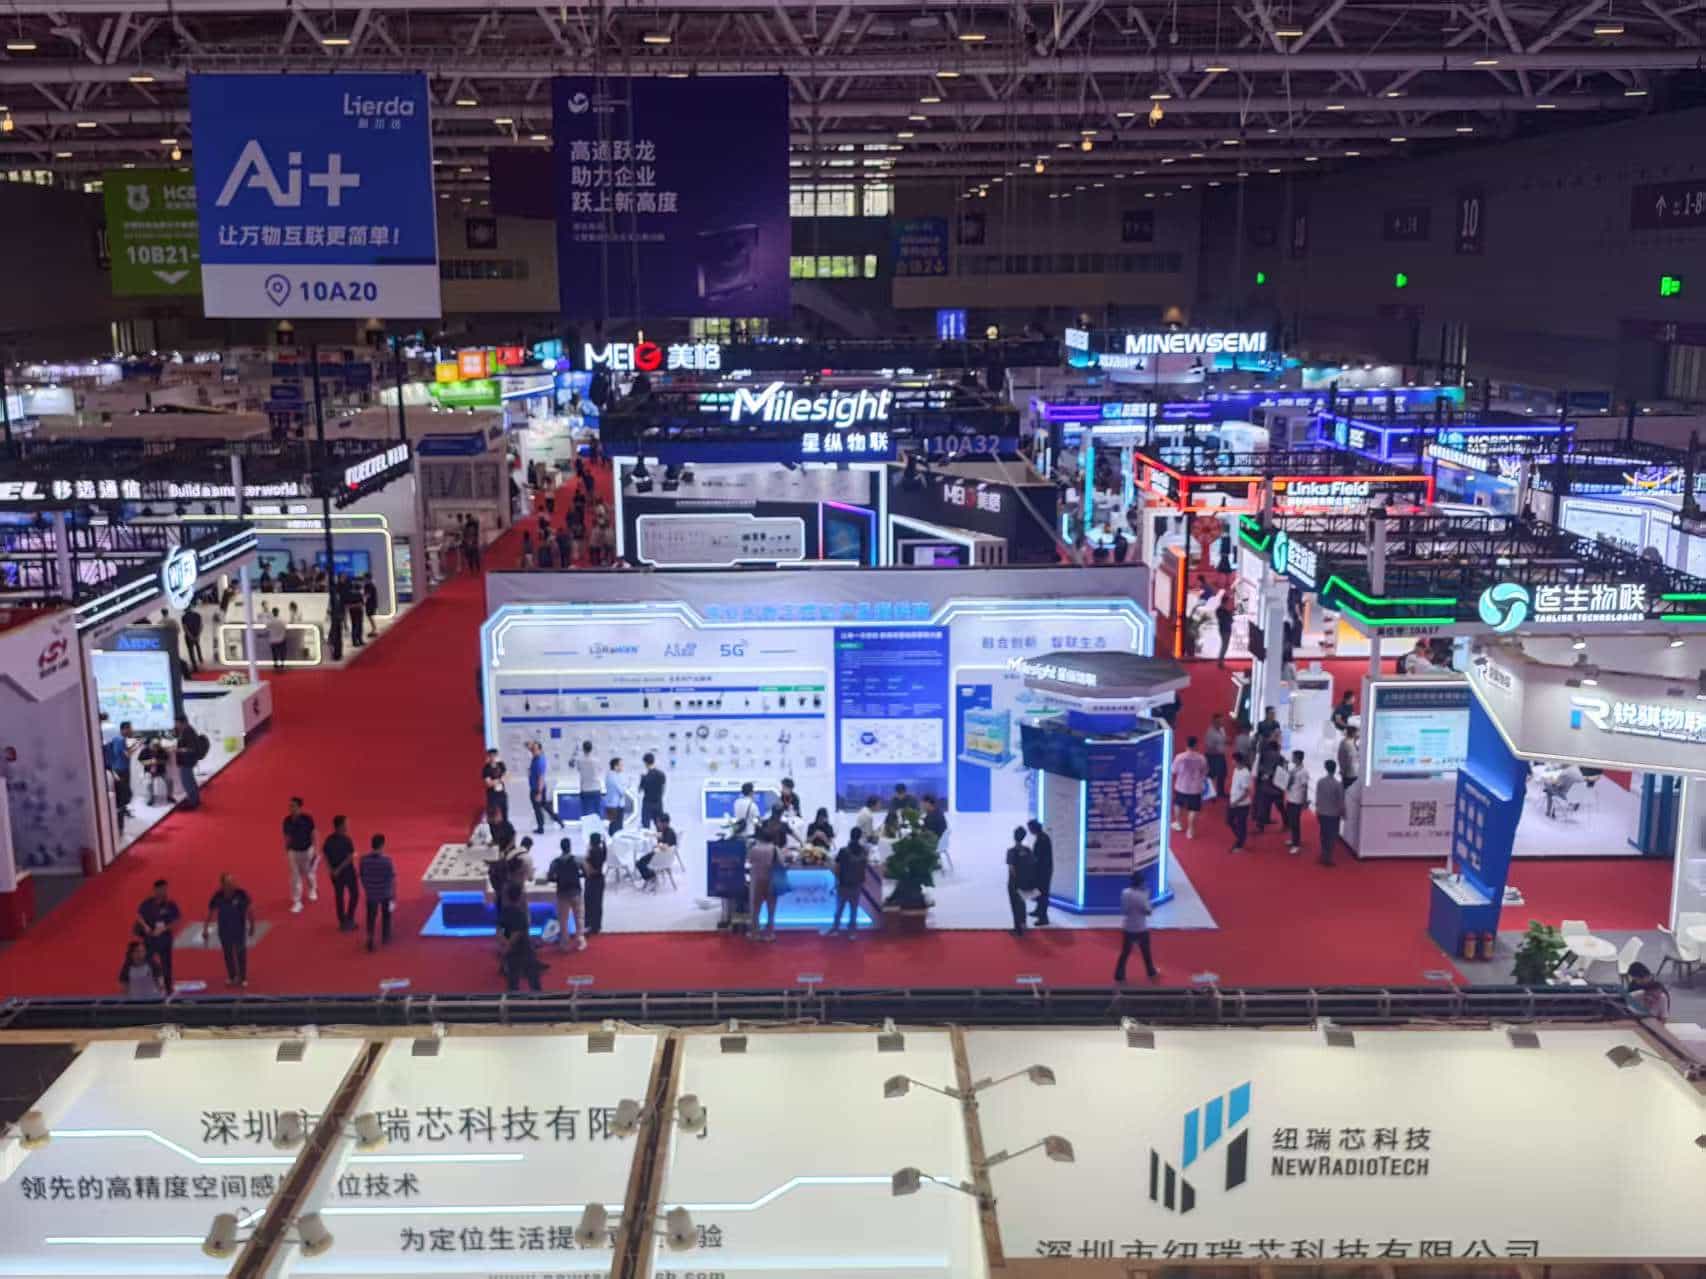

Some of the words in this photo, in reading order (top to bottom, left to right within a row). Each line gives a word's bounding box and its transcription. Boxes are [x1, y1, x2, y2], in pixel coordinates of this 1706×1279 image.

[343, 92, 415, 116] Lierda
[569, 139, 656, 162] 高通跃龙
[571, 165, 657, 187] 助力企业
[571, 190, 679, 214] 跃上新高度
[299, 281, 378, 301] 10A20
[1125, 332, 1267, 354] MINEWSEMI
[667, 343, 721, 370] 美格
[729, 381, 894, 428] Milesight
[801, 433, 889, 452] 星纵物联
[933, 434, 1000, 454] 10A32
[1286, 481, 1329, 496] Links
[1331, 481, 1369, 496] Field
[719, 643, 744, 656] 5G
[1271, 1127, 1431, 1151] 纽瑞芯科技
